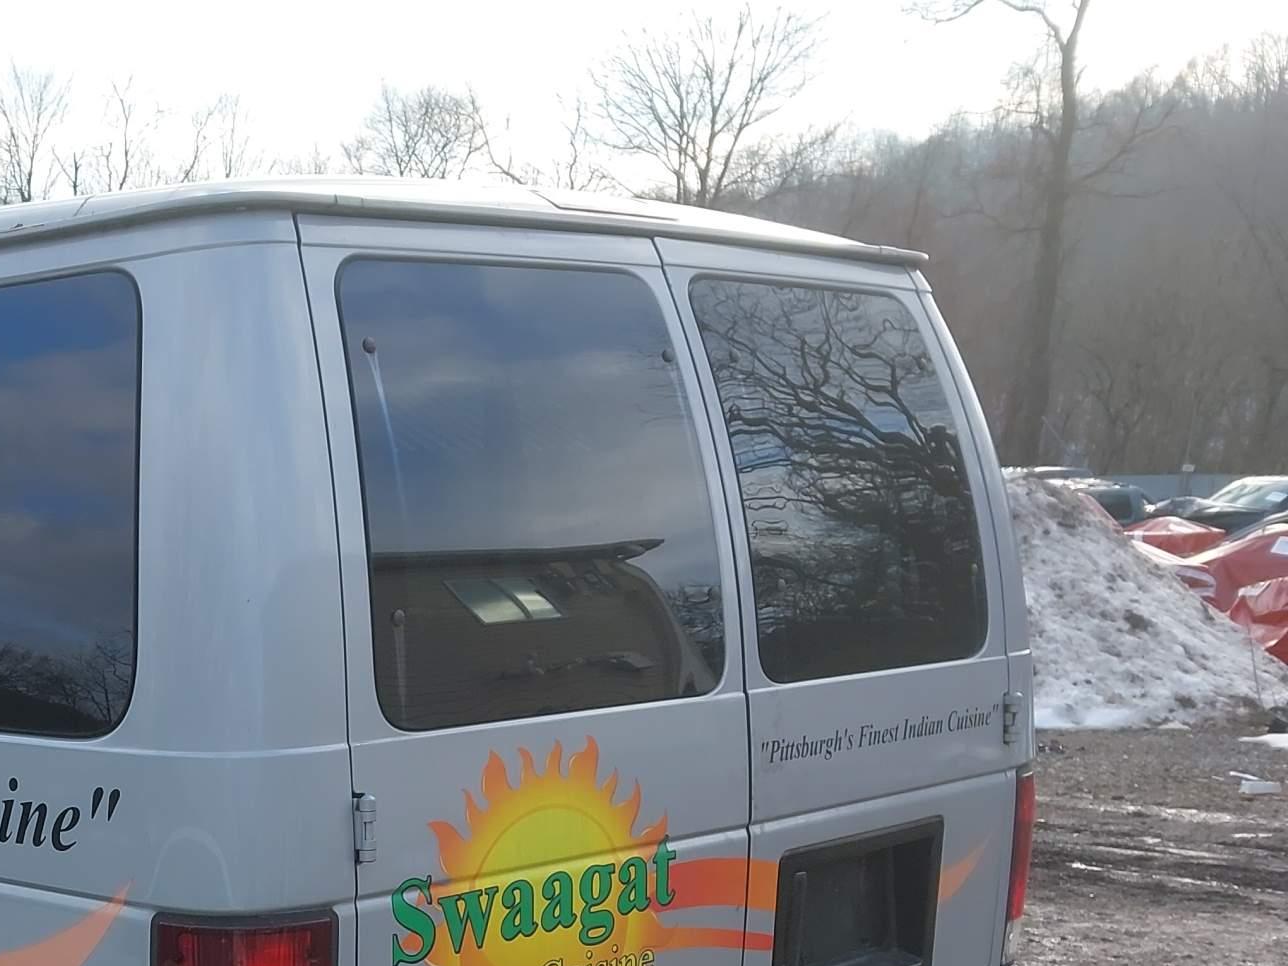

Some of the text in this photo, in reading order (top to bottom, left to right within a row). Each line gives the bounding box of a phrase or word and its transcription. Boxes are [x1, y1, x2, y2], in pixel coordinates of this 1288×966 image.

[761, 703, 999, 764] "Pittsburgh's Finest Indian Cuisine"
